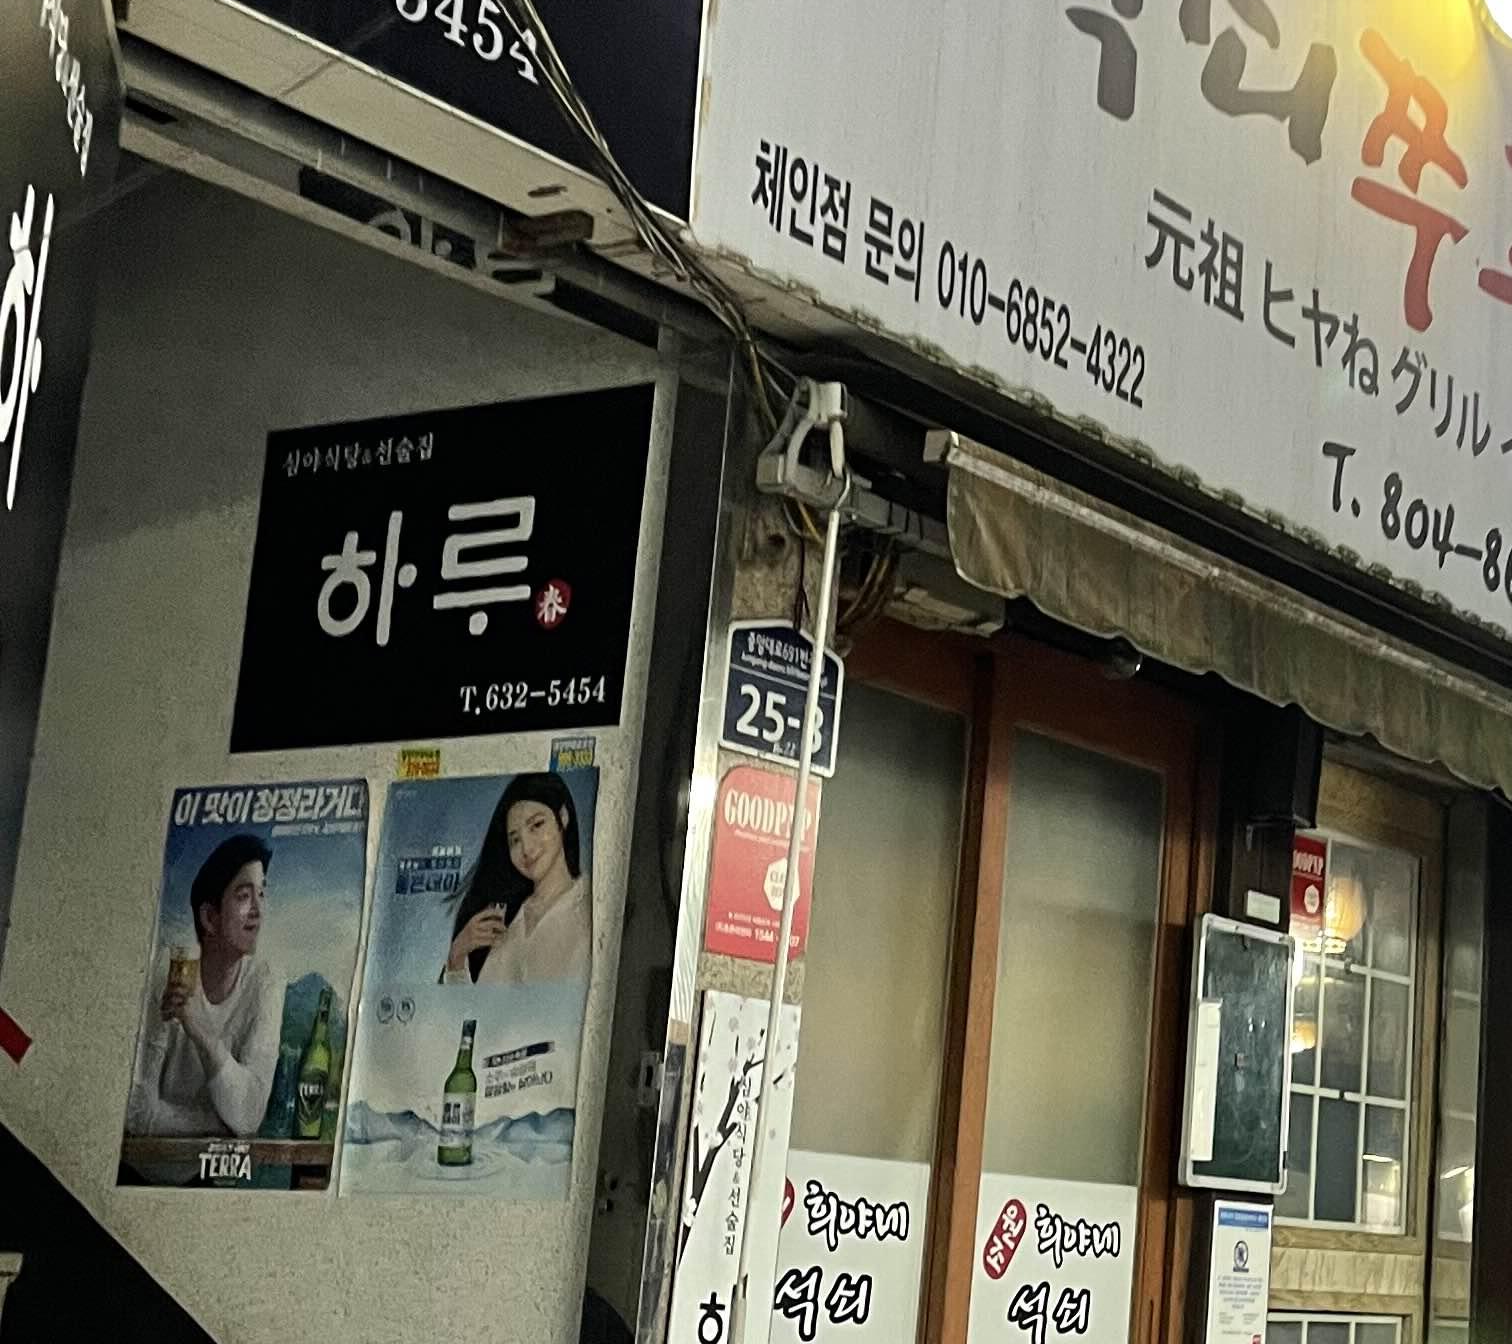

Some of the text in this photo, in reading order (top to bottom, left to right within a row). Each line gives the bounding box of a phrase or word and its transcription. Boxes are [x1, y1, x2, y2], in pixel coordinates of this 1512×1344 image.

[750, 138, 1147, 409] 체인점 문의 010-6852-4322
[317, 495, 536, 647] 하루
[459, 676, 607, 716] T.632-5454
[198, 1151, 252, 1182] TERRA
[803, 1179, 910, 1248] 희야네
[1034, 1205, 1121, 1268] 희야네
[774, 1266, 873, 1342] 석쇠
